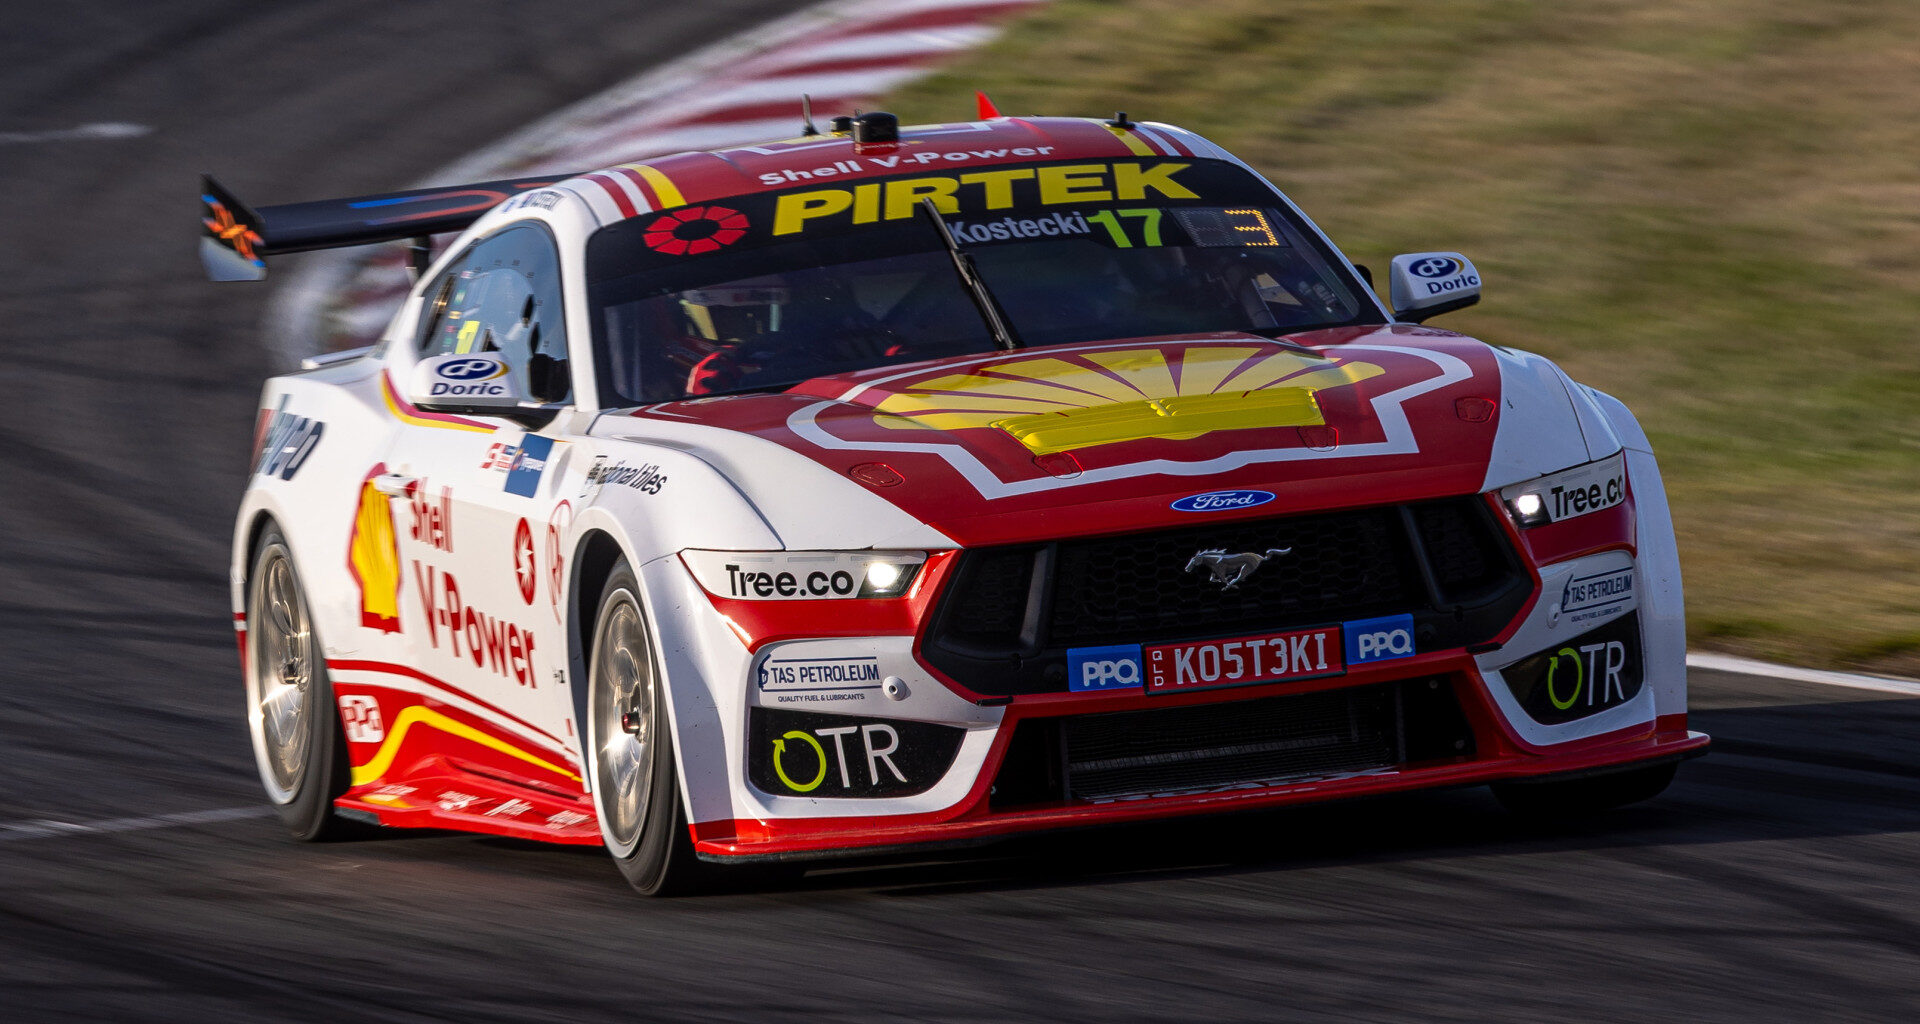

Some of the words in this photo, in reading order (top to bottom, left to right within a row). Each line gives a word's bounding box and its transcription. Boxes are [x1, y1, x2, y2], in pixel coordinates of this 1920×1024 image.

[758, 159, 864, 186] Shell
[870, 145, 1055, 169] V-Power
[772, 162, 1201, 236] PIRTEK
[946, 210, 1091, 244] Kostecki
[1086, 208, 1163, 248] 17
[1426, 274, 1479, 295] Doric
[431, 382, 505, 396] Doric
[1192, 492, 1255, 509] Ford
[725, 564, 854, 597] Tree.co
[1571, 584, 1586, 604] TAS
[1587, 573, 1632, 600] PETROLEUM
[411, 559, 538, 690] V-Power
[1358, 628, 1413, 659] PPQ
[770, 667, 796, 684] TAS
[799, 663, 880, 683] PETROLEUM
[1082, 658, 1140, 687] PPQ
[1548, 640, 1625, 710] OTR
[777, 695, 803, 703] QUALITY
[804, 694, 818, 702] FUEL
[826, 693, 865, 702] LUBRICANTS
[772, 723, 908, 793] OTR
